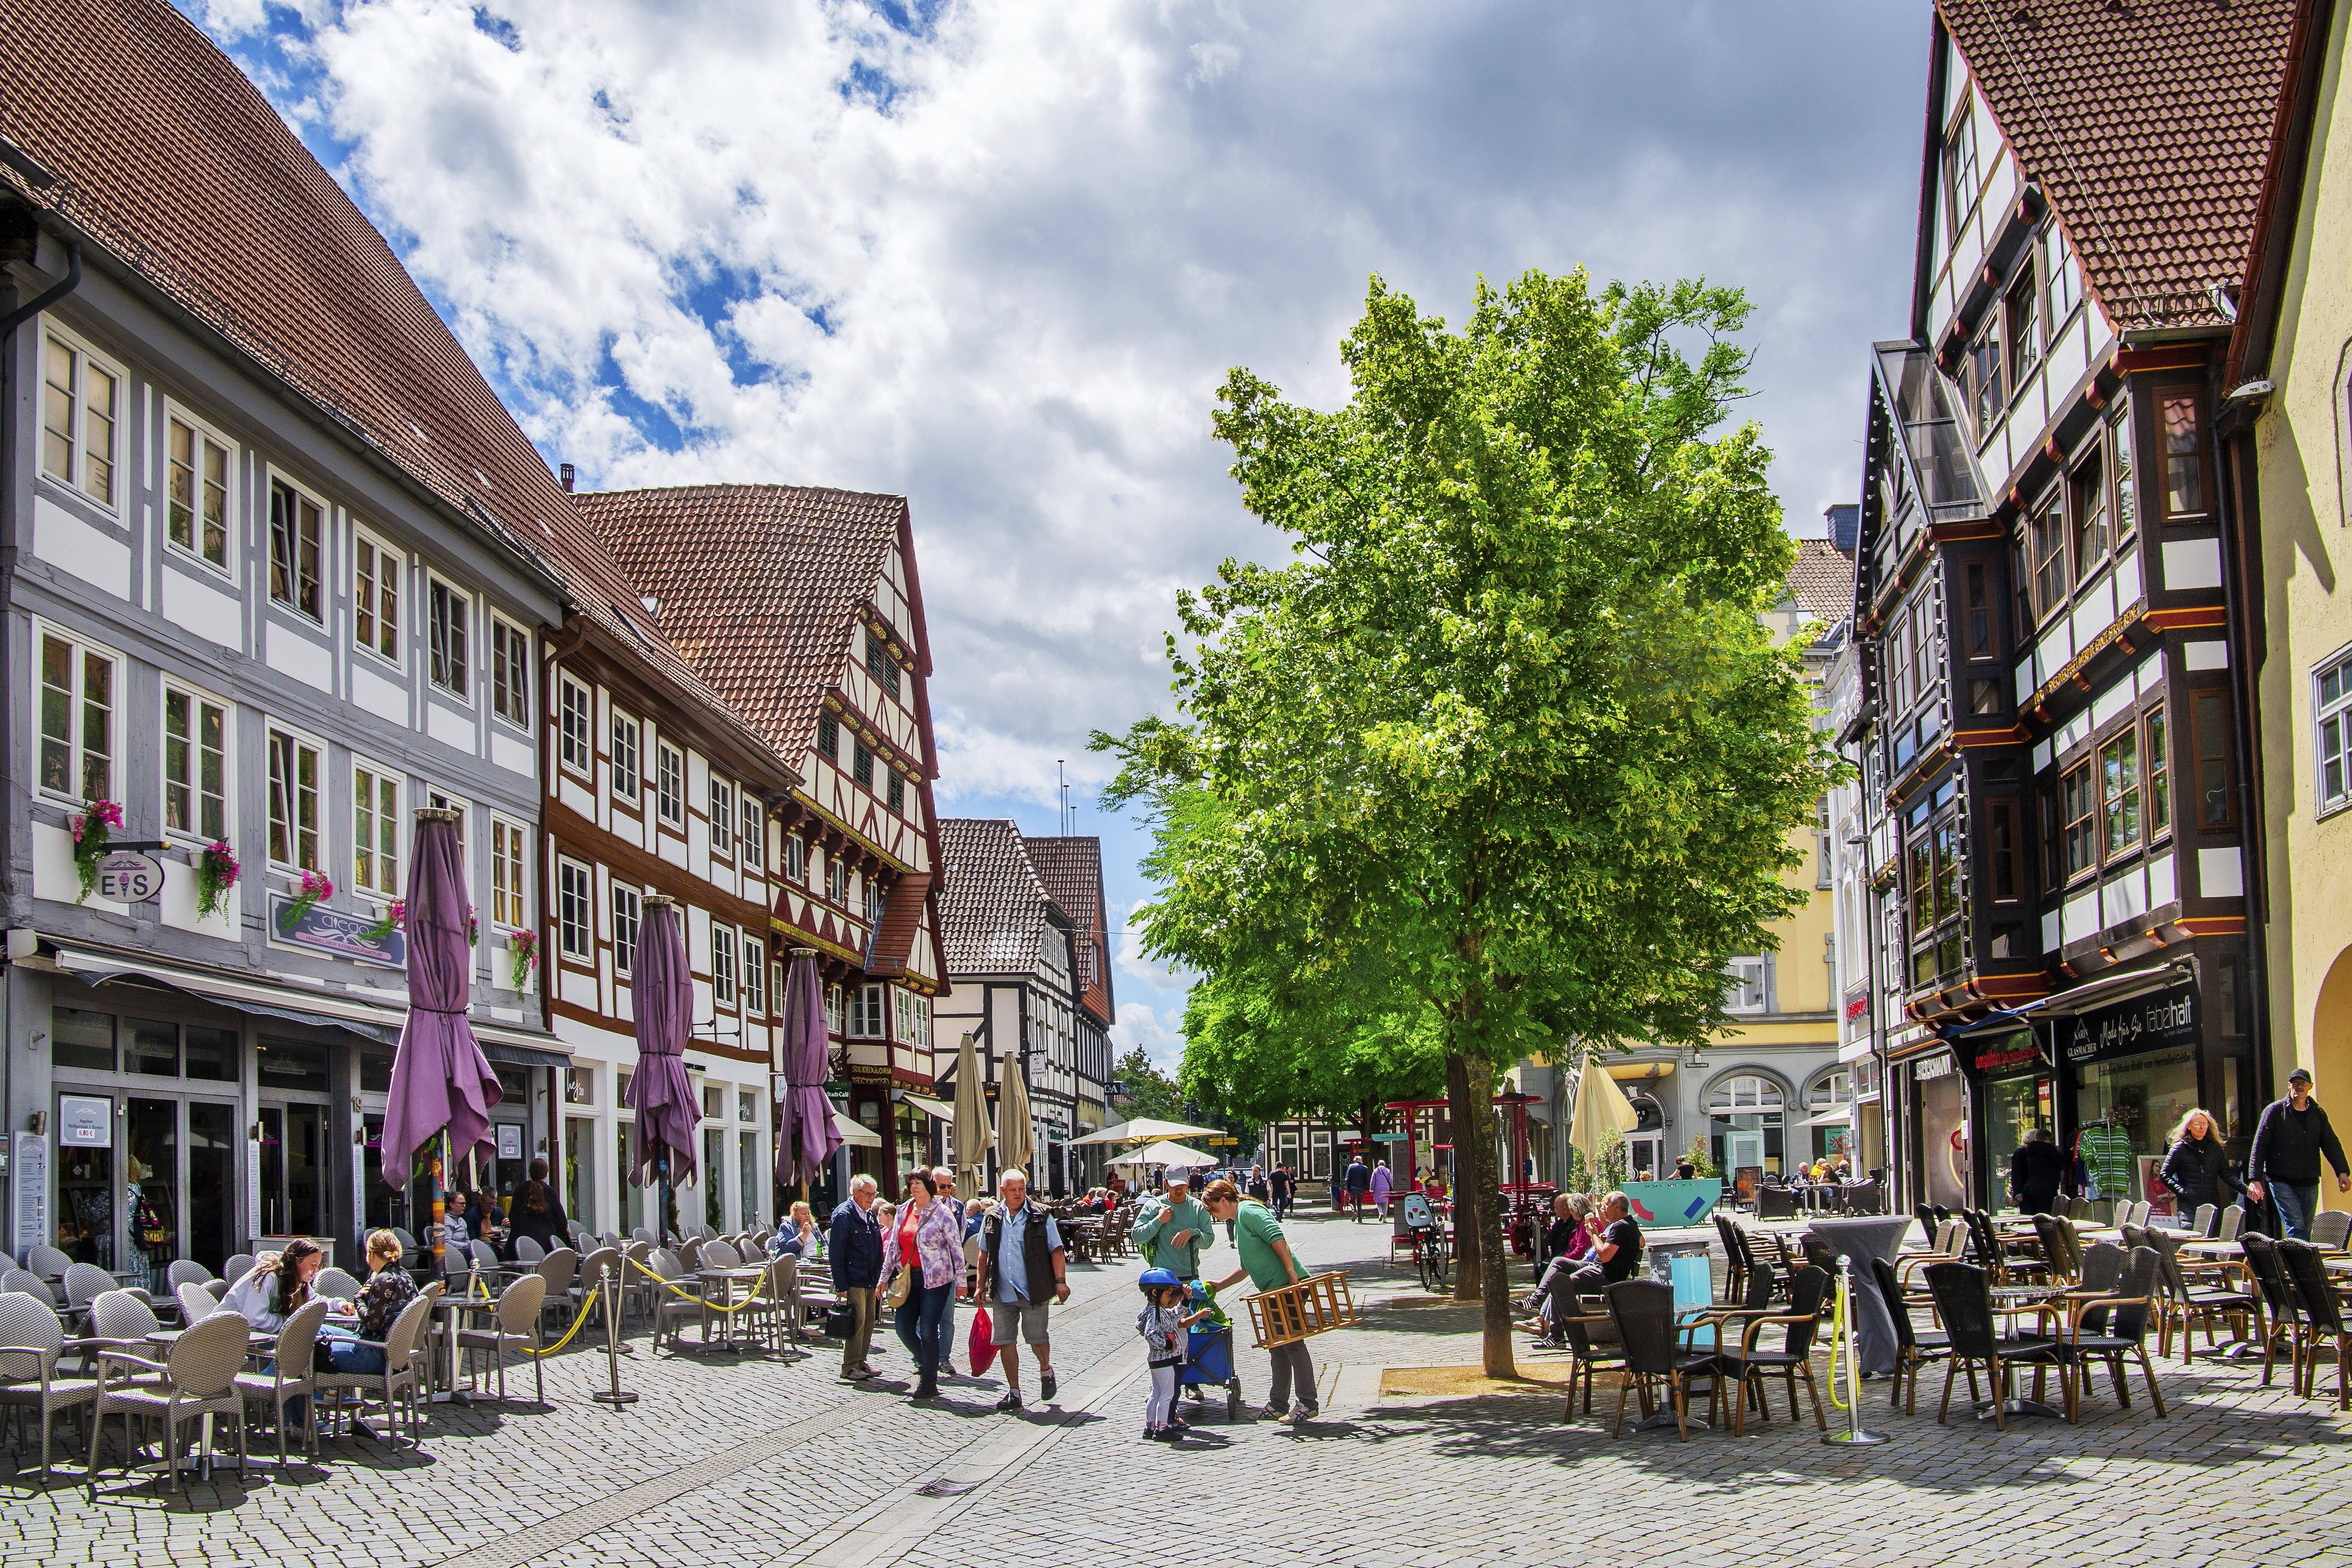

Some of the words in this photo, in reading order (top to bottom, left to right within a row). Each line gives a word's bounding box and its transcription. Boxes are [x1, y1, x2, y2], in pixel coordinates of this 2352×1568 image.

[306, 936, 336, 947] HAMELNER
[337, 943, 383, 958] EISMANUFAKTUR
[2147, 995, 2191, 1032] fabelhaft
[2074, 1029, 2089, 1040] KARIN
[2100, 1019, 2117, 1049] Mode
[2118, 1014, 2130, 1046] für
[2131, 1014, 2143, 1041] Sie
[2067, 1042, 2097, 1057] GLASMACHER
[1104, 1085, 1118, 1093] C&A
